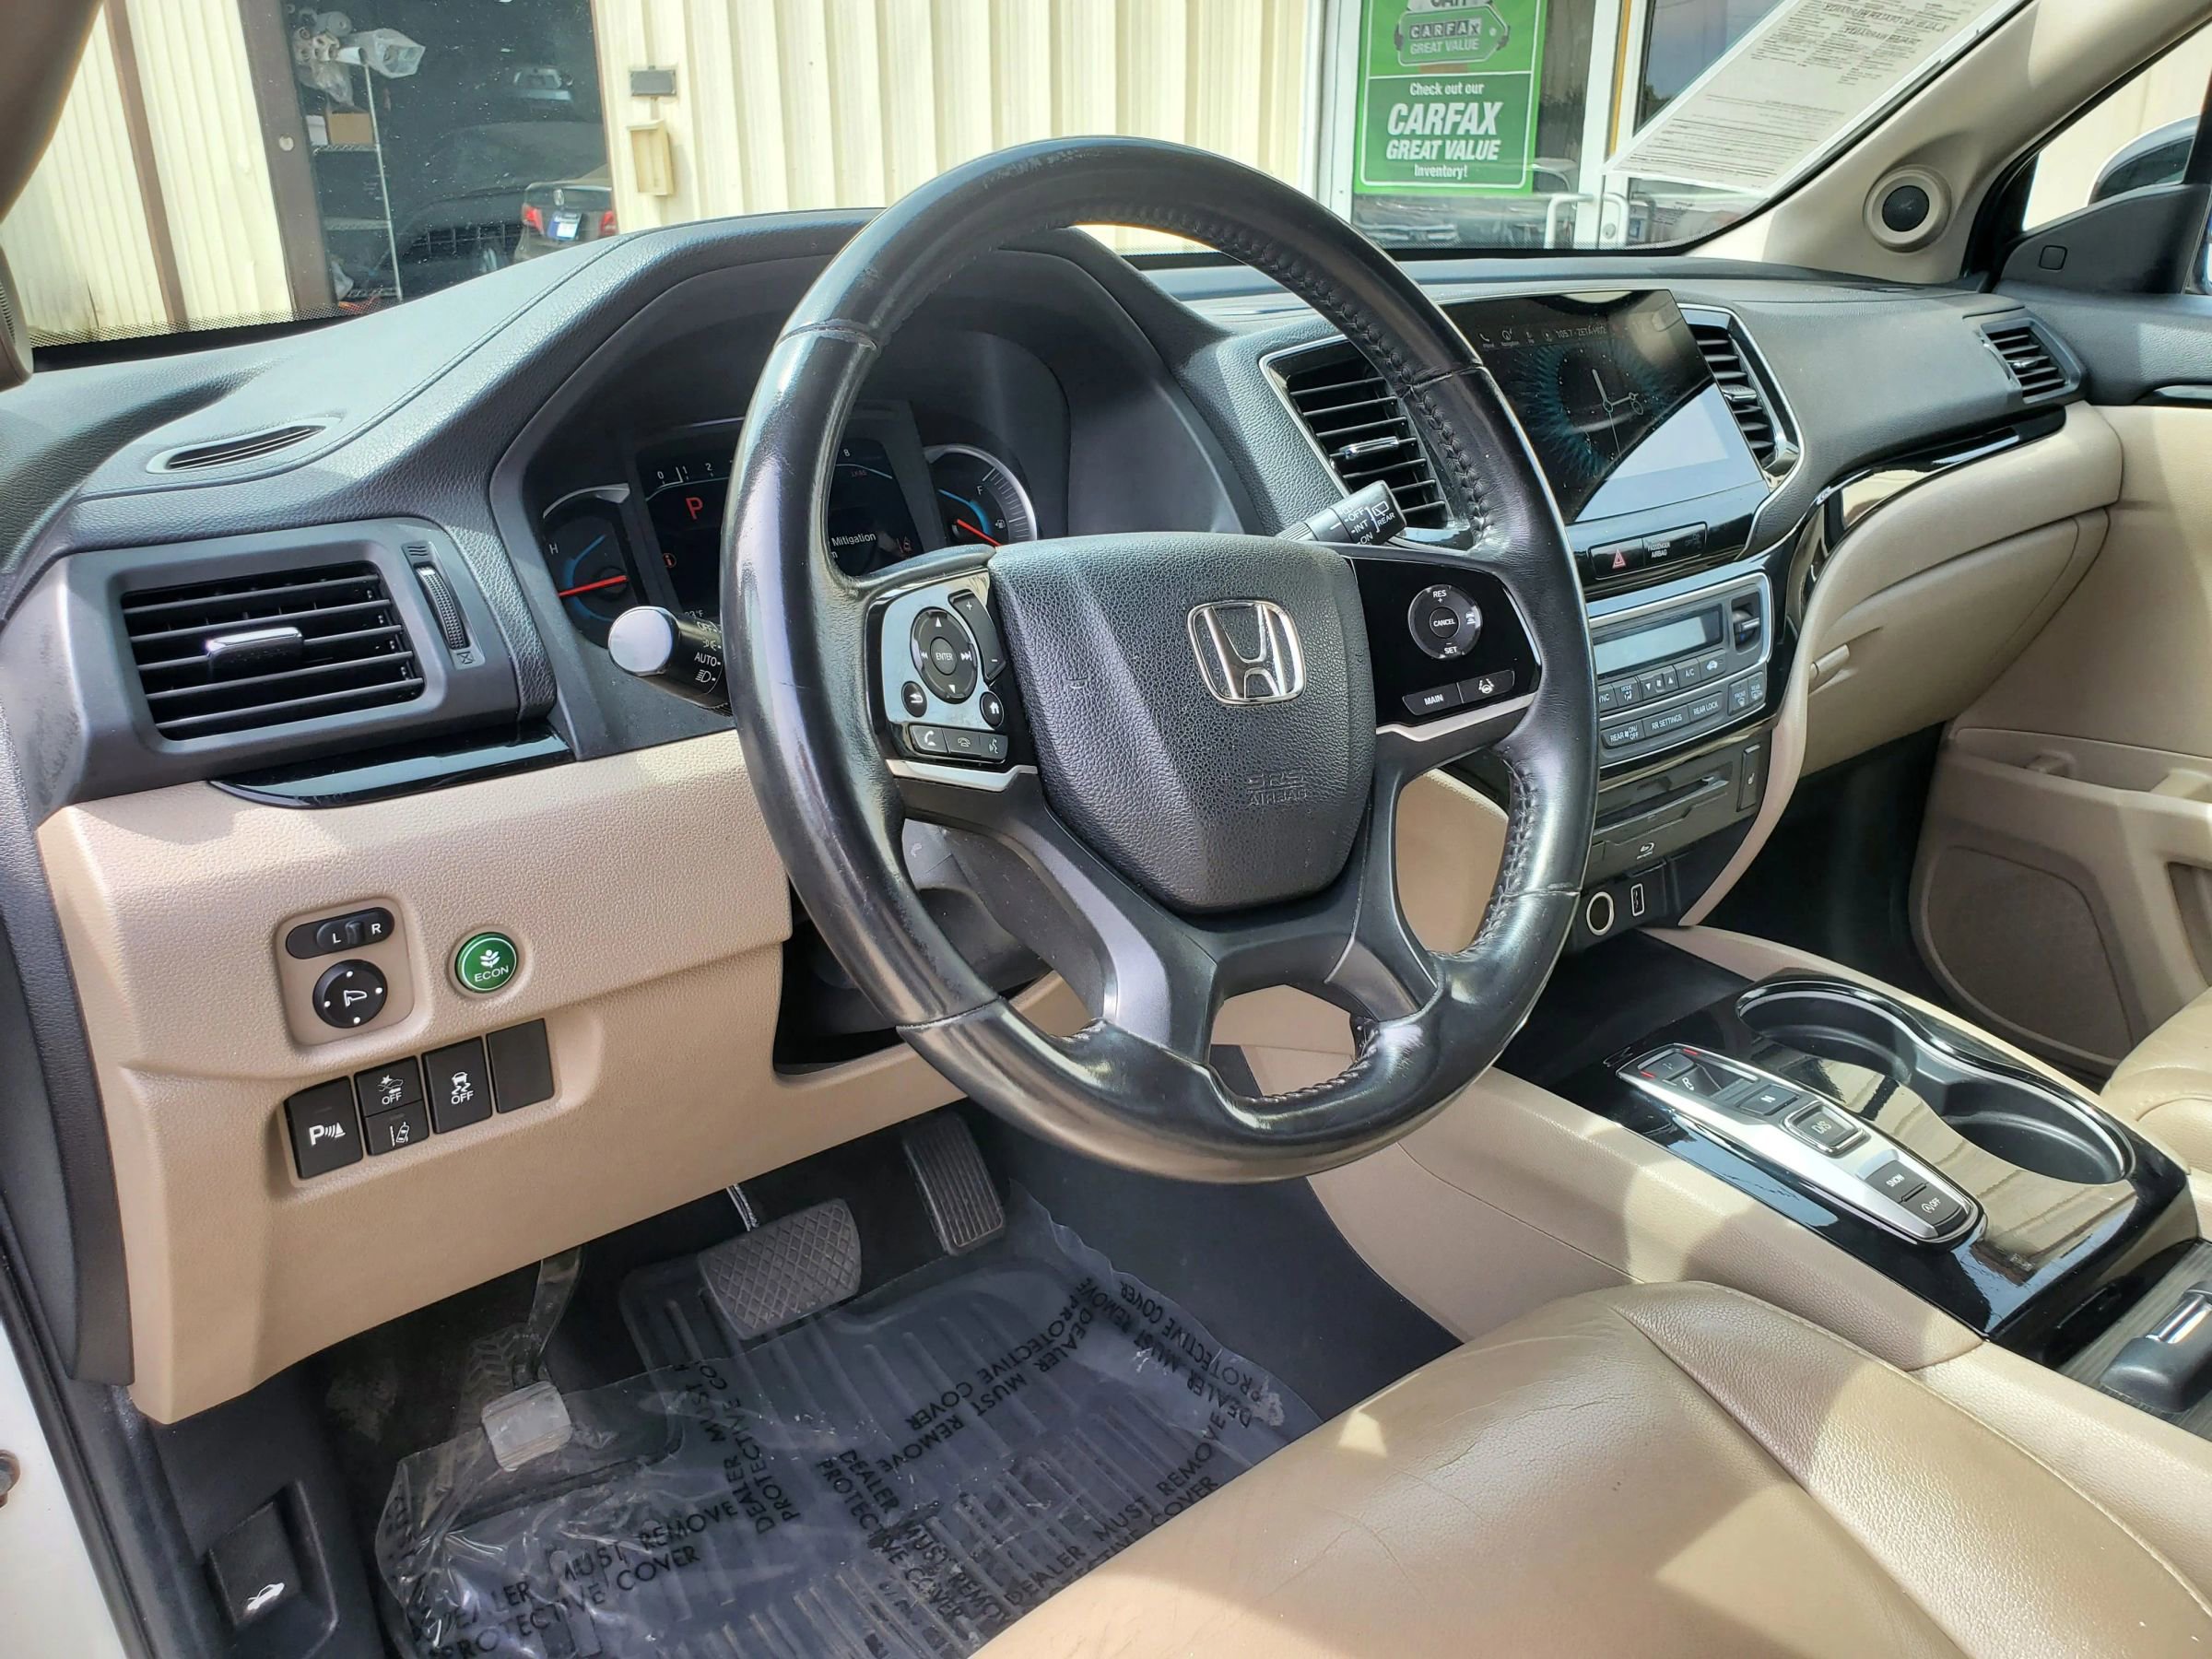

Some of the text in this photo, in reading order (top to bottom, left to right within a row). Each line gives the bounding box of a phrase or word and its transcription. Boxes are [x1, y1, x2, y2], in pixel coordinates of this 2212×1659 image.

[1410, 18, 1482, 39] CARFAX
[1410, 39, 1479, 54] GREAT VALUE
[1410, 82, 1485, 96] Check out our
[1387, 101, 1503, 135] CARFAX
[1386, 140, 1501, 160] GREAT VALUE
[1414, 164, 1468, 180] Inventory!
[842, 449, 852, 457] 8
[657, 463, 712, 480] 0 1 2
[976, 486, 984, 496] F
[685, 497, 704, 521] P
[1347, 506, 1365, 522] OFF
[1354, 519, 1369, 534] INT
[1377, 512, 1396, 527] REAR
[831, 533, 877, 547] Mitigation
[1359, 531, 1373, 545] ON
[547, 543, 559, 555] H
[1432, 589, 1447, 598] RES
[1433, 618, 1456, 628] CANCEL
[935, 652, 954, 662] ENTER
[1444, 646, 1458, 654] SET
[694, 652, 717, 667] AUTO
[1685, 667, 1695, 677] A/C
[1621, 684, 1632, 692] MODE
[1424, 694, 1444, 705] MAIN
[1693, 700, 1719, 716] REAR LOCK
[1658, 713, 1683, 729] SETTINGS
[1610, 732, 1625, 743] REAR
[1629, 733, 1640, 741] OFF
[371, 923, 382, 935] R
[332, 932, 341, 944] L
[473, 965, 510, 983] ECON
[382, 1092, 403, 1106] OFF
[451, 1090, 475, 1106] OFF
[1760, 1094, 1776, 1103] N
[308, 1124, 325, 1146] P
[1886, 1173, 1905, 1187] SNOW
[1929, 1197, 1942, 1208] OFF
[1120, 1281, 1264, 1403] PROTECTIVE COVER
[1076, 1277, 1253, 1429] DEALER MUST REMOVE
[904, 1294, 1082, 1431] PROTECTIVE COVER
[876, 1307, 1094, 1473] DEALER MUST REMOVE
[685, 1383, 776, 1535] DEALER MUST
[723, 1397, 801, 1522] PROTECTIVE
[838, 1449, 900, 1514] DEALER
[1004, 1545, 1087, 1606] DEALER
[1092, 1495, 1153, 1543] MUST
[1155, 1412, 1227, 1498] REMOVE
[637, 1500, 739, 1550] REMOVE
[616, 1546, 702, 1592] COVER
